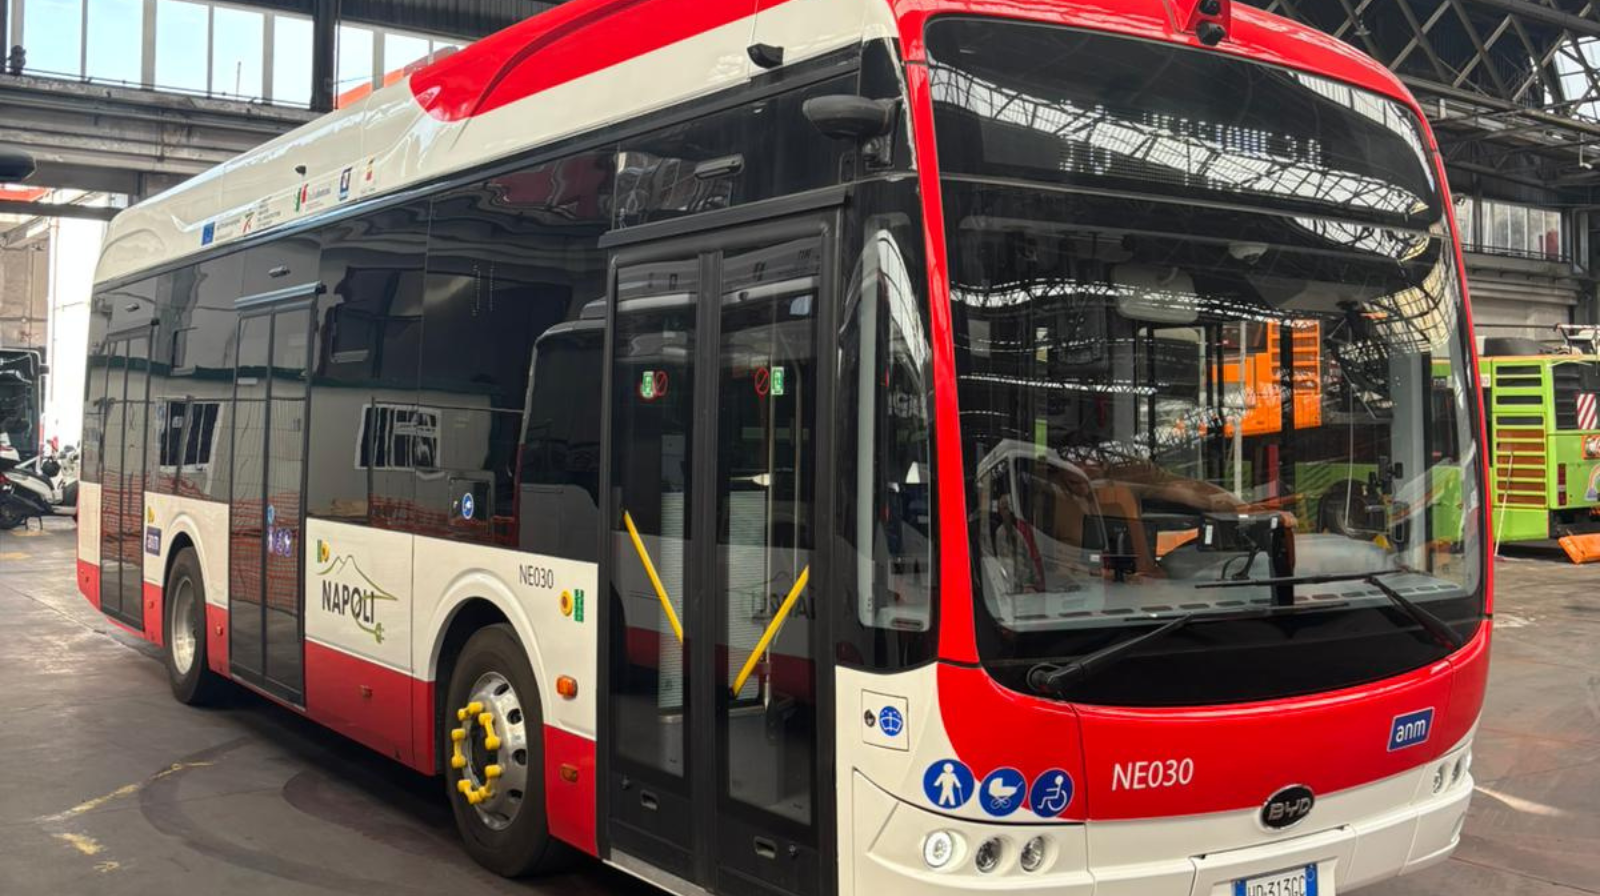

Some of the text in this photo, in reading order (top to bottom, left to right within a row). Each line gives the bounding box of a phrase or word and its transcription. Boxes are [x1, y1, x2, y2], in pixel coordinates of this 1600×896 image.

[519, 563, 554, 590] NE030
[321, 579, 375, 625] NAPOLI
[1395, 719, 1426, 743] anm
[1111, 757, 1194, 792] NE030
[1267, 797, 1311, 821] BYD
